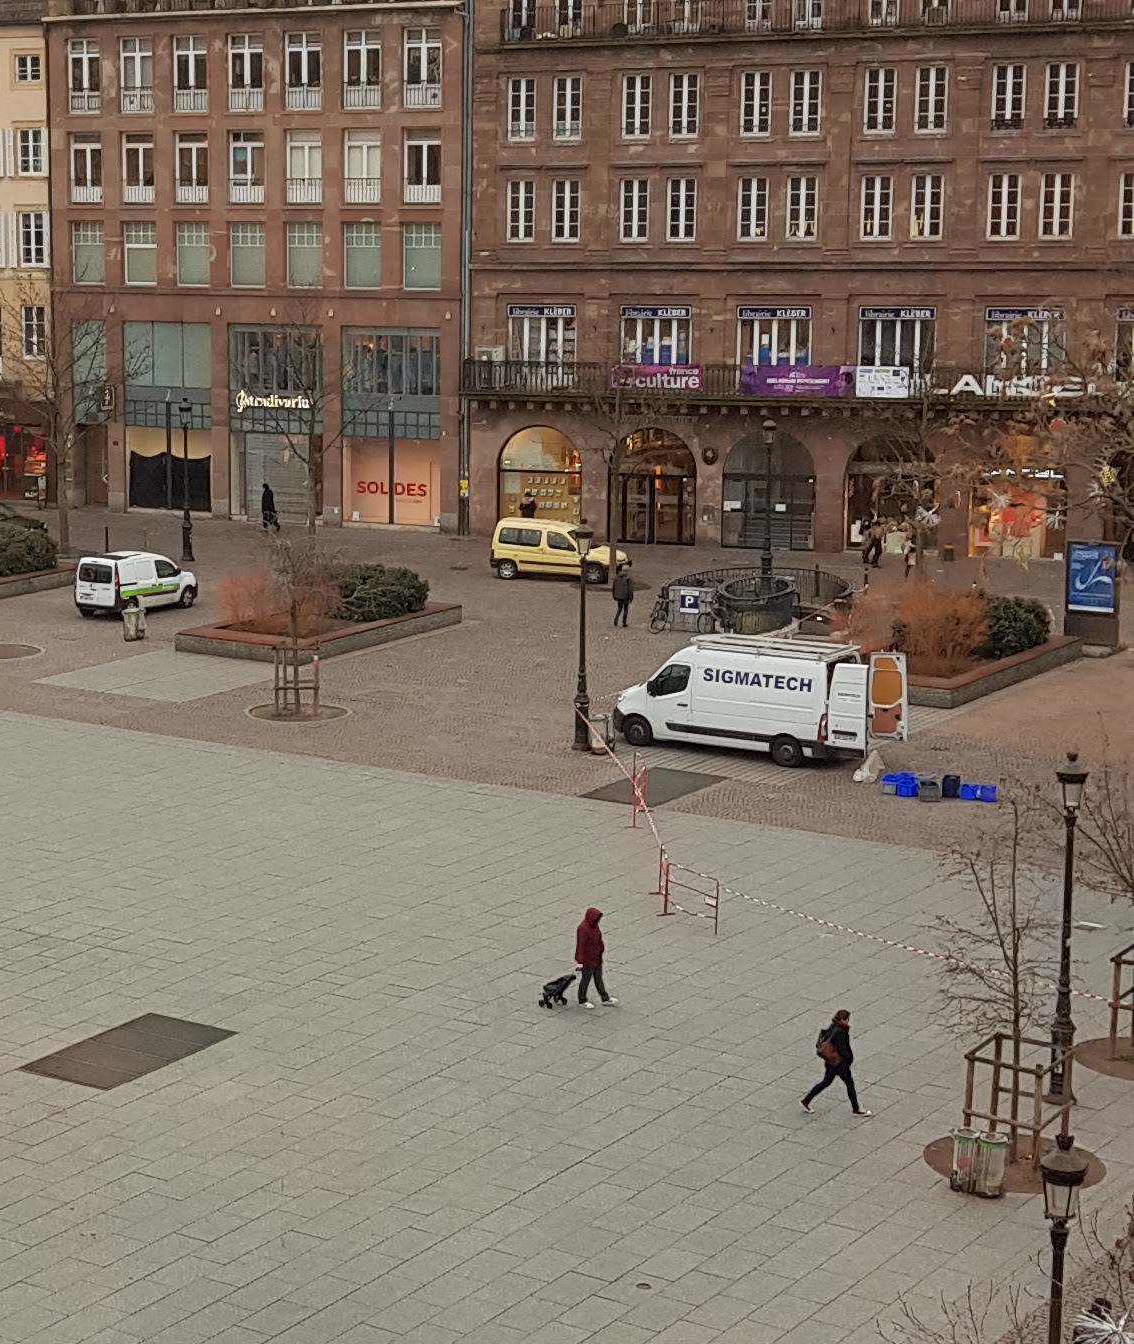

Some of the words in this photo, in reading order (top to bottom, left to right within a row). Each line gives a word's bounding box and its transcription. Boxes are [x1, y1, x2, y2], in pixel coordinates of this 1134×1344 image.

[669, 367, 700, 375] france
[635, 373, 700, 389] culture
[356, 480, 427, 497] SOLDES
[685, 596, 695, 607] P
[703, 667, 813, 693] SIGMATECH
